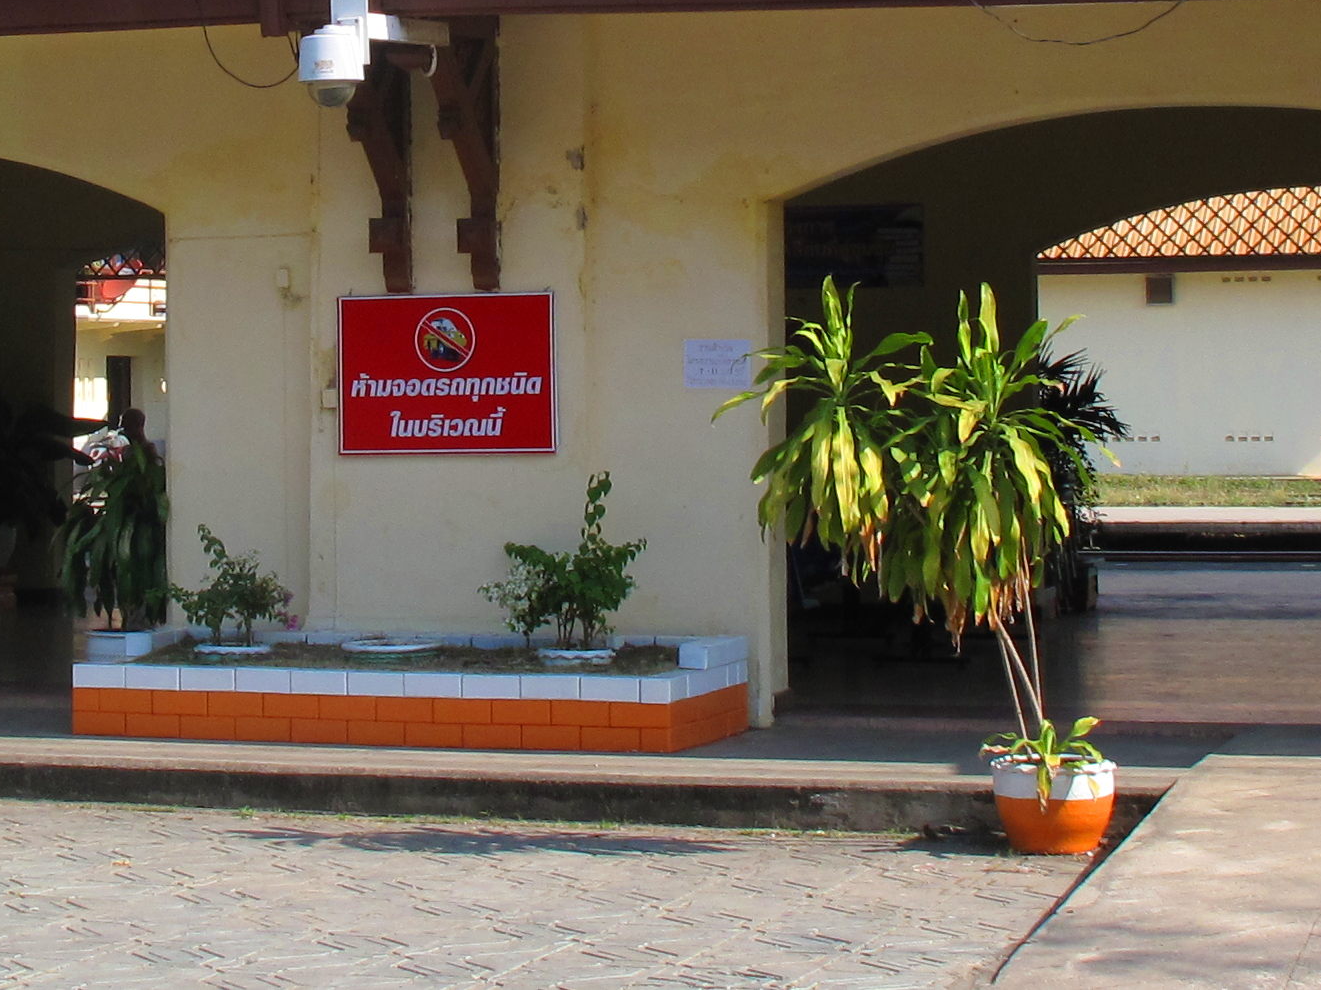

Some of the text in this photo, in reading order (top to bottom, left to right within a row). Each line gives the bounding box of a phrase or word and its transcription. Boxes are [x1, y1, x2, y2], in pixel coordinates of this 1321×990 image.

[351, 372, 542, 402] ห้ามจอดรถทุกชนิด
[390, 407, 506, 438] ในบริเวณนี้
